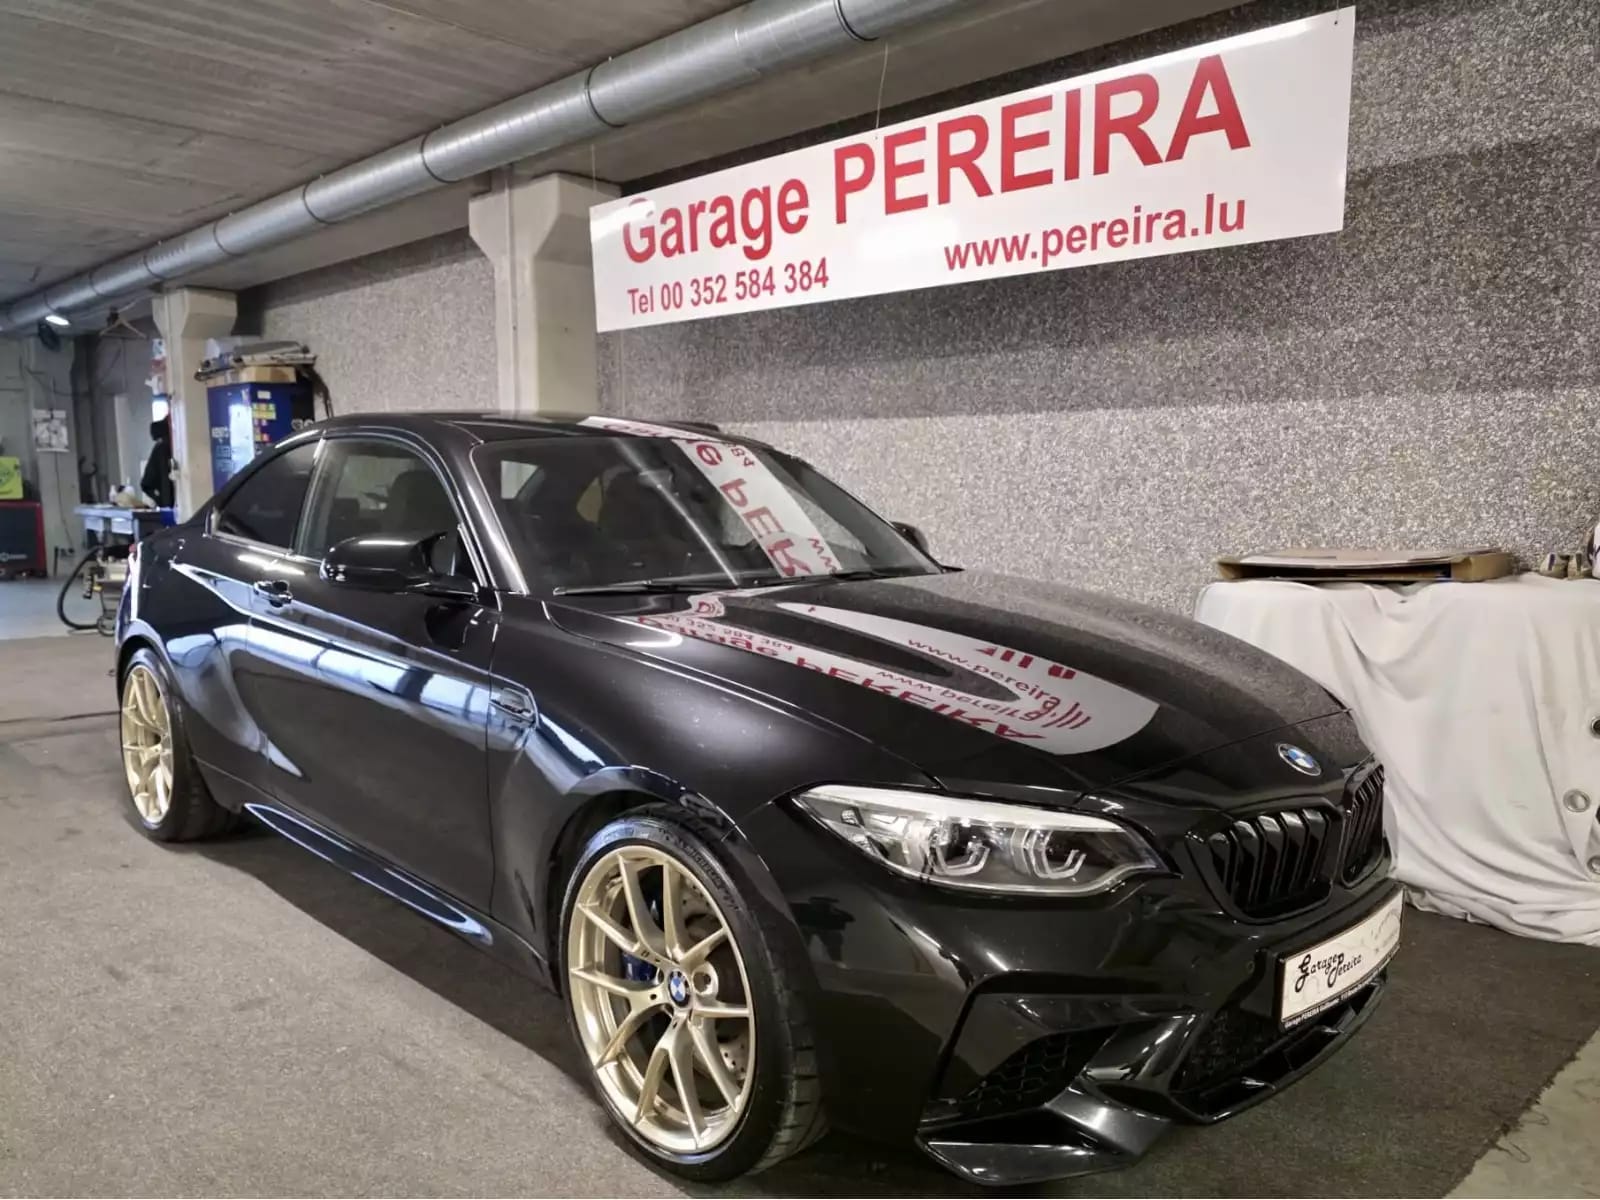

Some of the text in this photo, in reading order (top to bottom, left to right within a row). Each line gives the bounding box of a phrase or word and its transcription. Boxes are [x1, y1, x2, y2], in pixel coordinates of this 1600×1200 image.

[622, 55, 1251, 264] Garage PEREIRA
[944, 192, 1247, 270] www.pereira.lu
[627, 256, 830, 315] Tel 00 352 584 384
[1294, 953, 1340, 994] Garage
